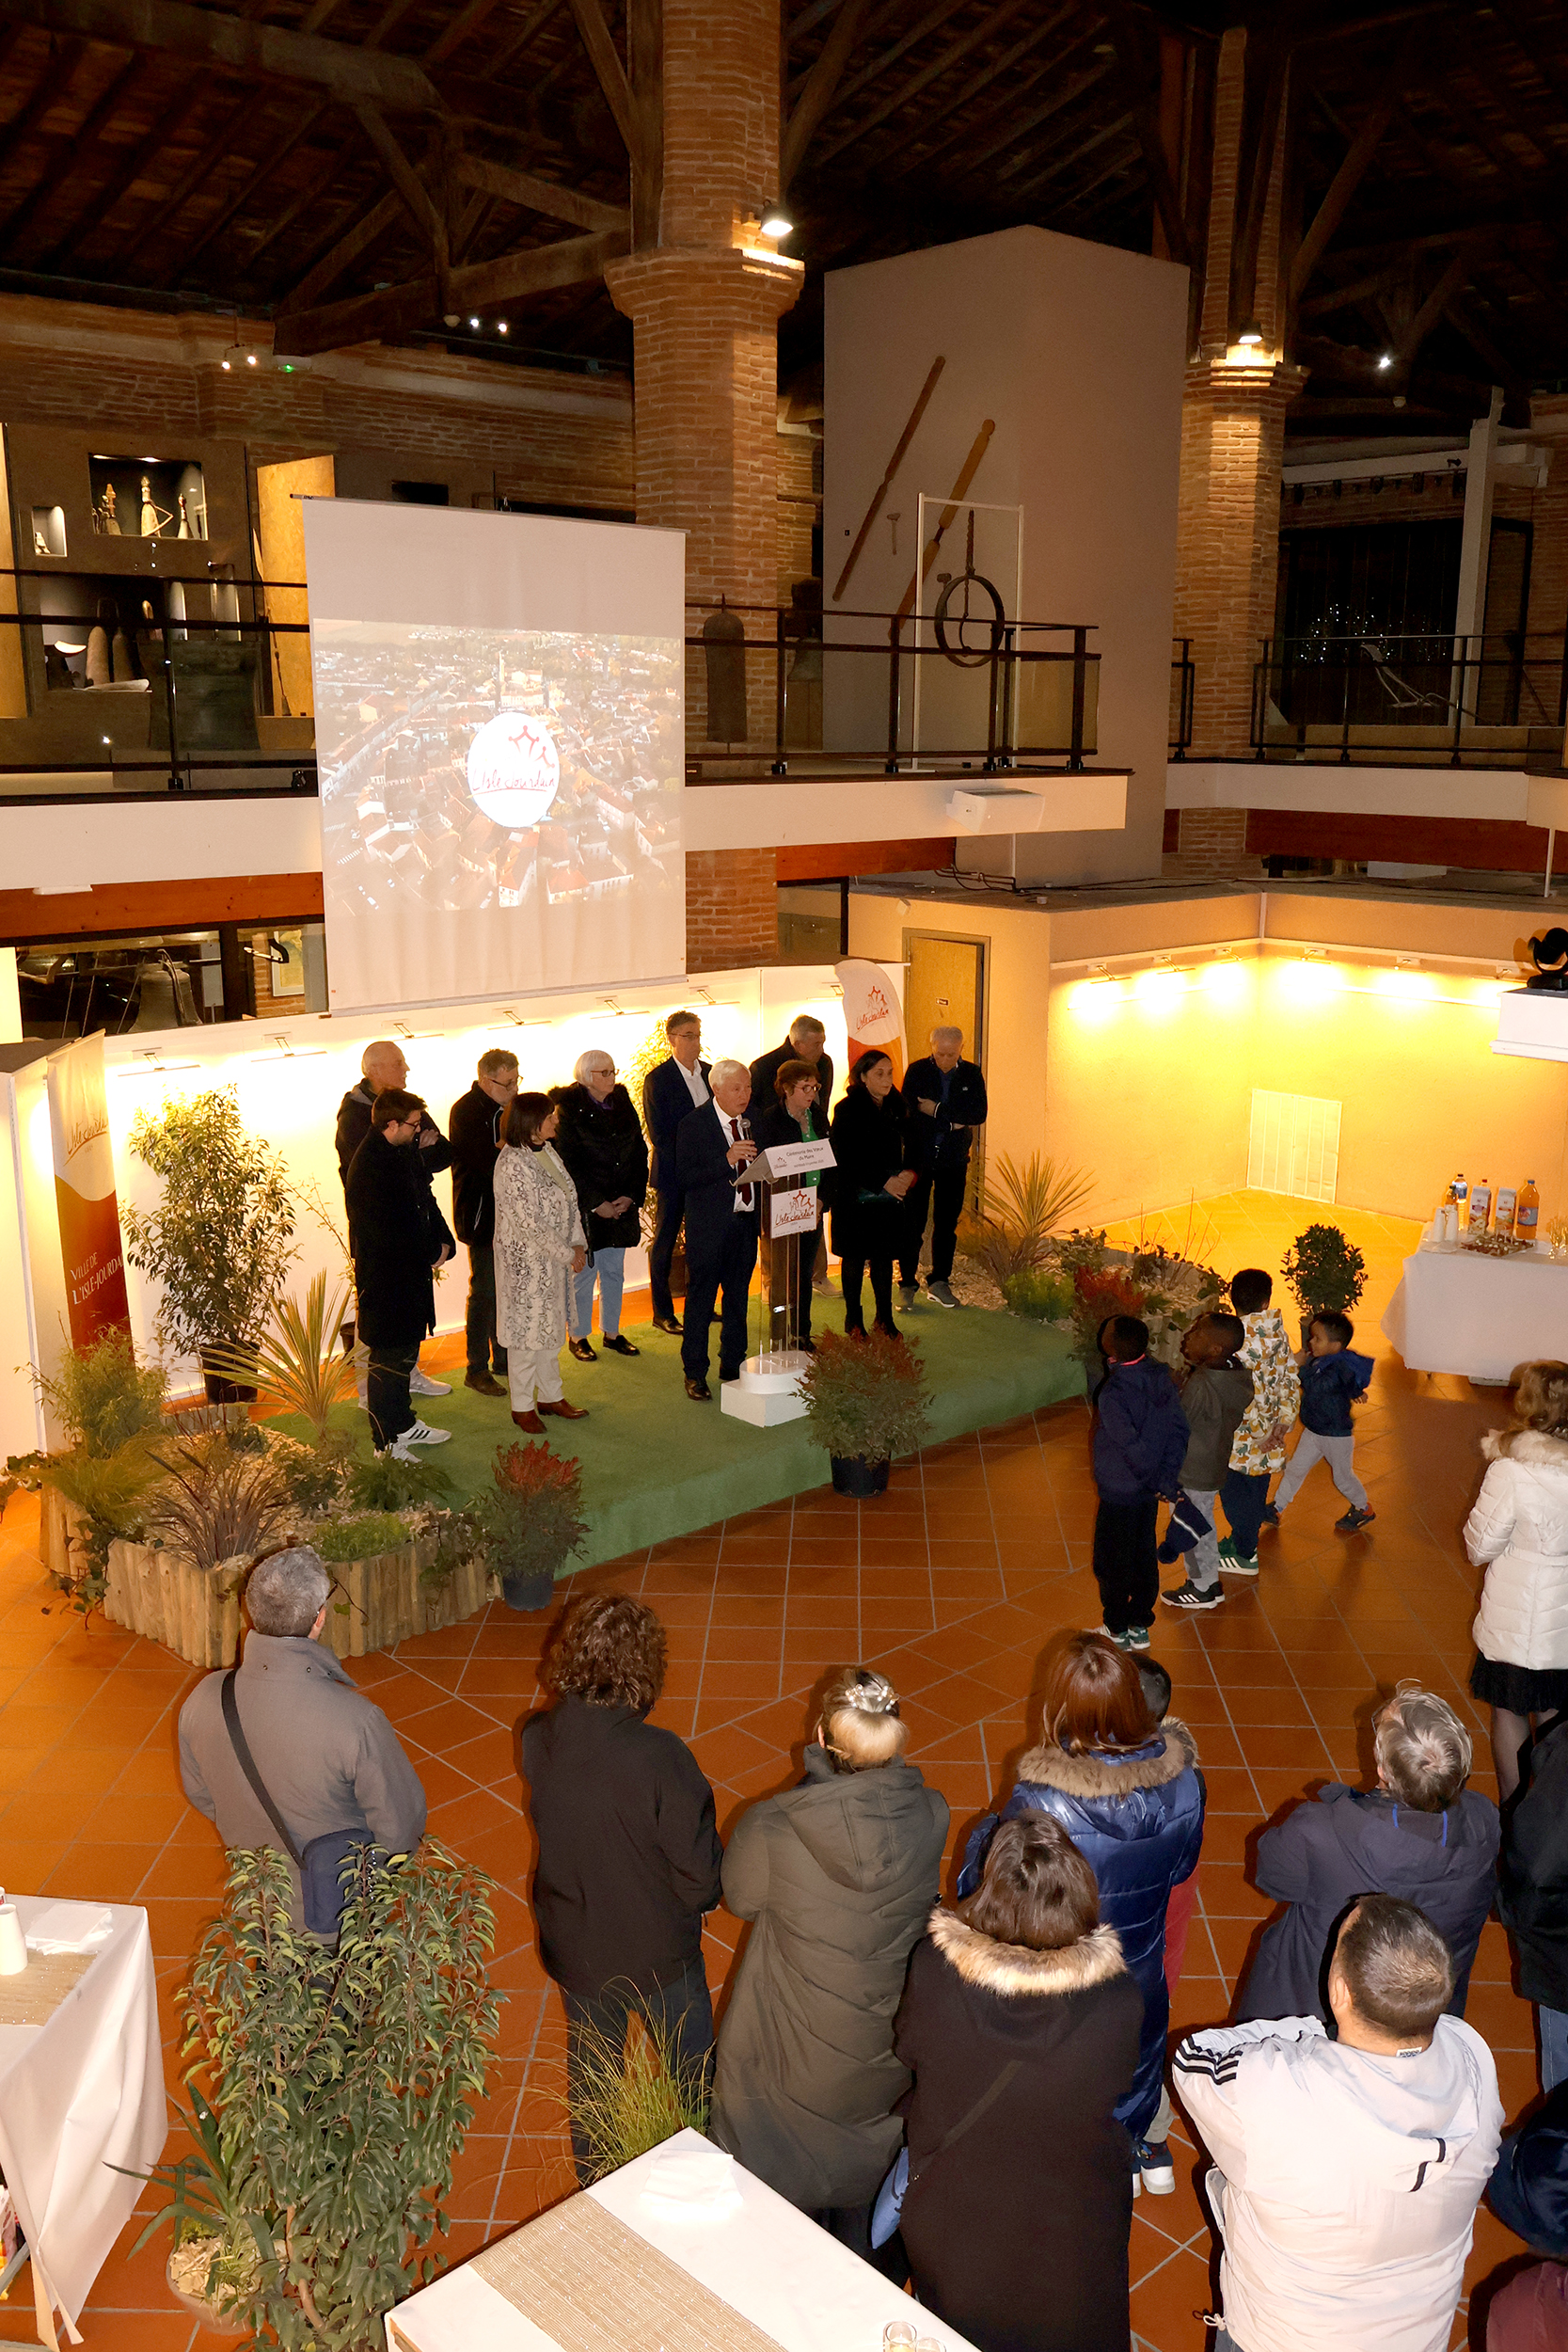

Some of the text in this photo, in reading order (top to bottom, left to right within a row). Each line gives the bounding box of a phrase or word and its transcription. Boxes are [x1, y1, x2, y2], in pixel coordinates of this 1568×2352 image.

[504, 769, 555, 789] Jourdain
[70, 1251, 99, 1281] VILLE DE
